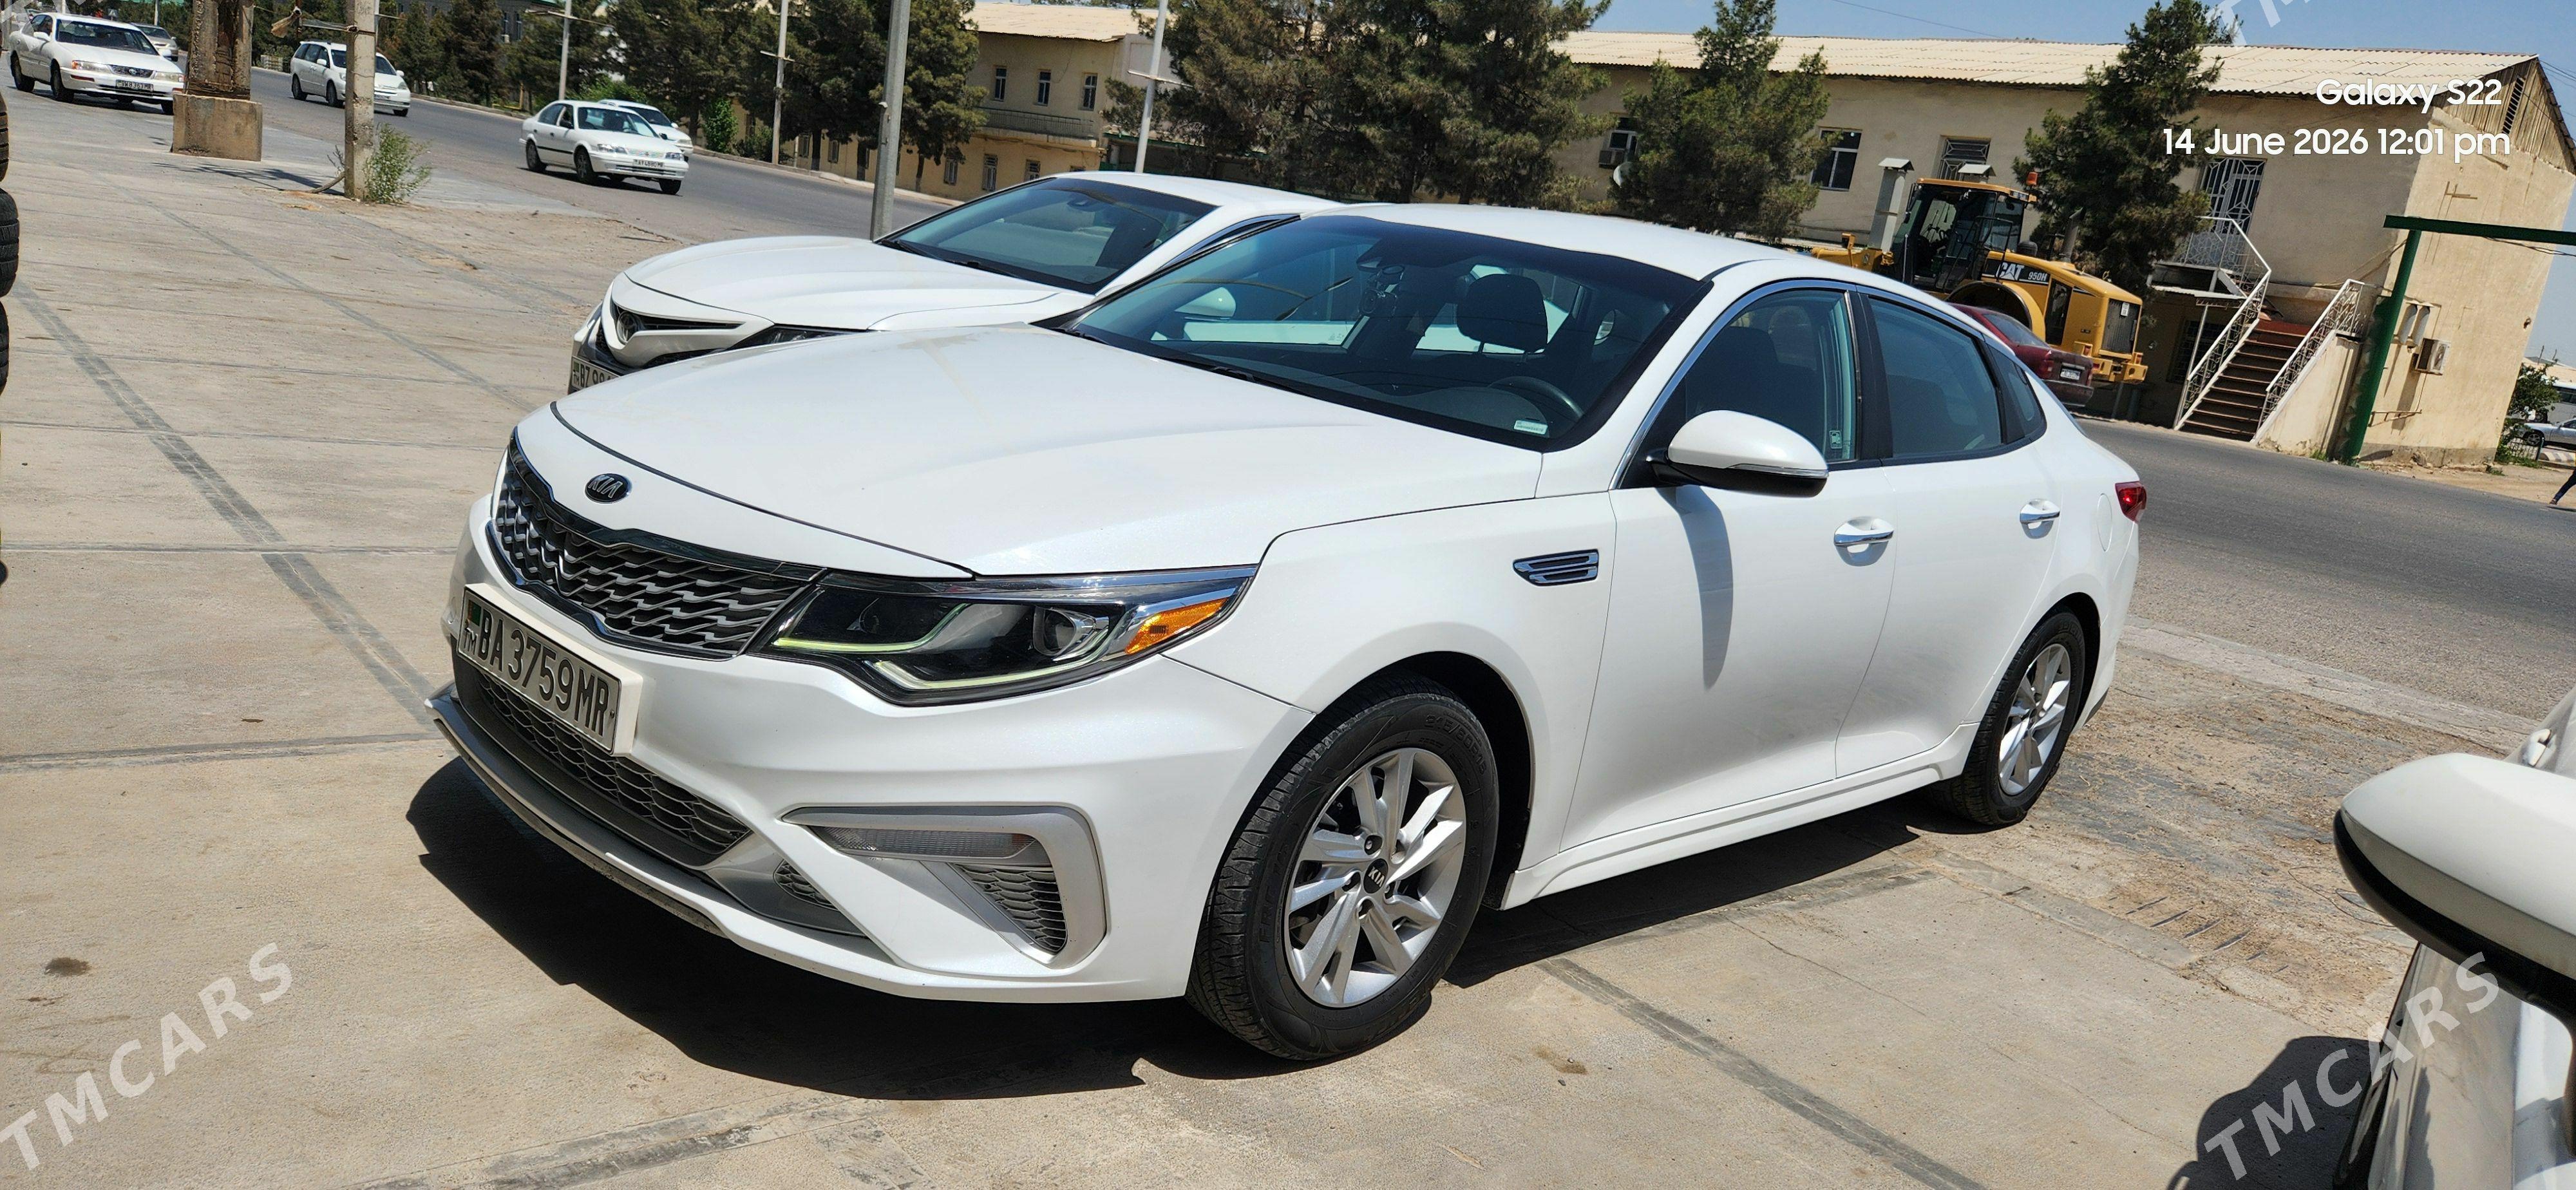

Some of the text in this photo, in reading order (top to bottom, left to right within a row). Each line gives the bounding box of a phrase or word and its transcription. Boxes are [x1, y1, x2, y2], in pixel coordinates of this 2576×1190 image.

[1996, 261, 2048, 281] CAT 950H
[587, 475, 623, 498] KIA
[464, 627, 478, 656] TM
[481, 610, 503, 672] BA
[1368, 865, 1385, 887] KIA
